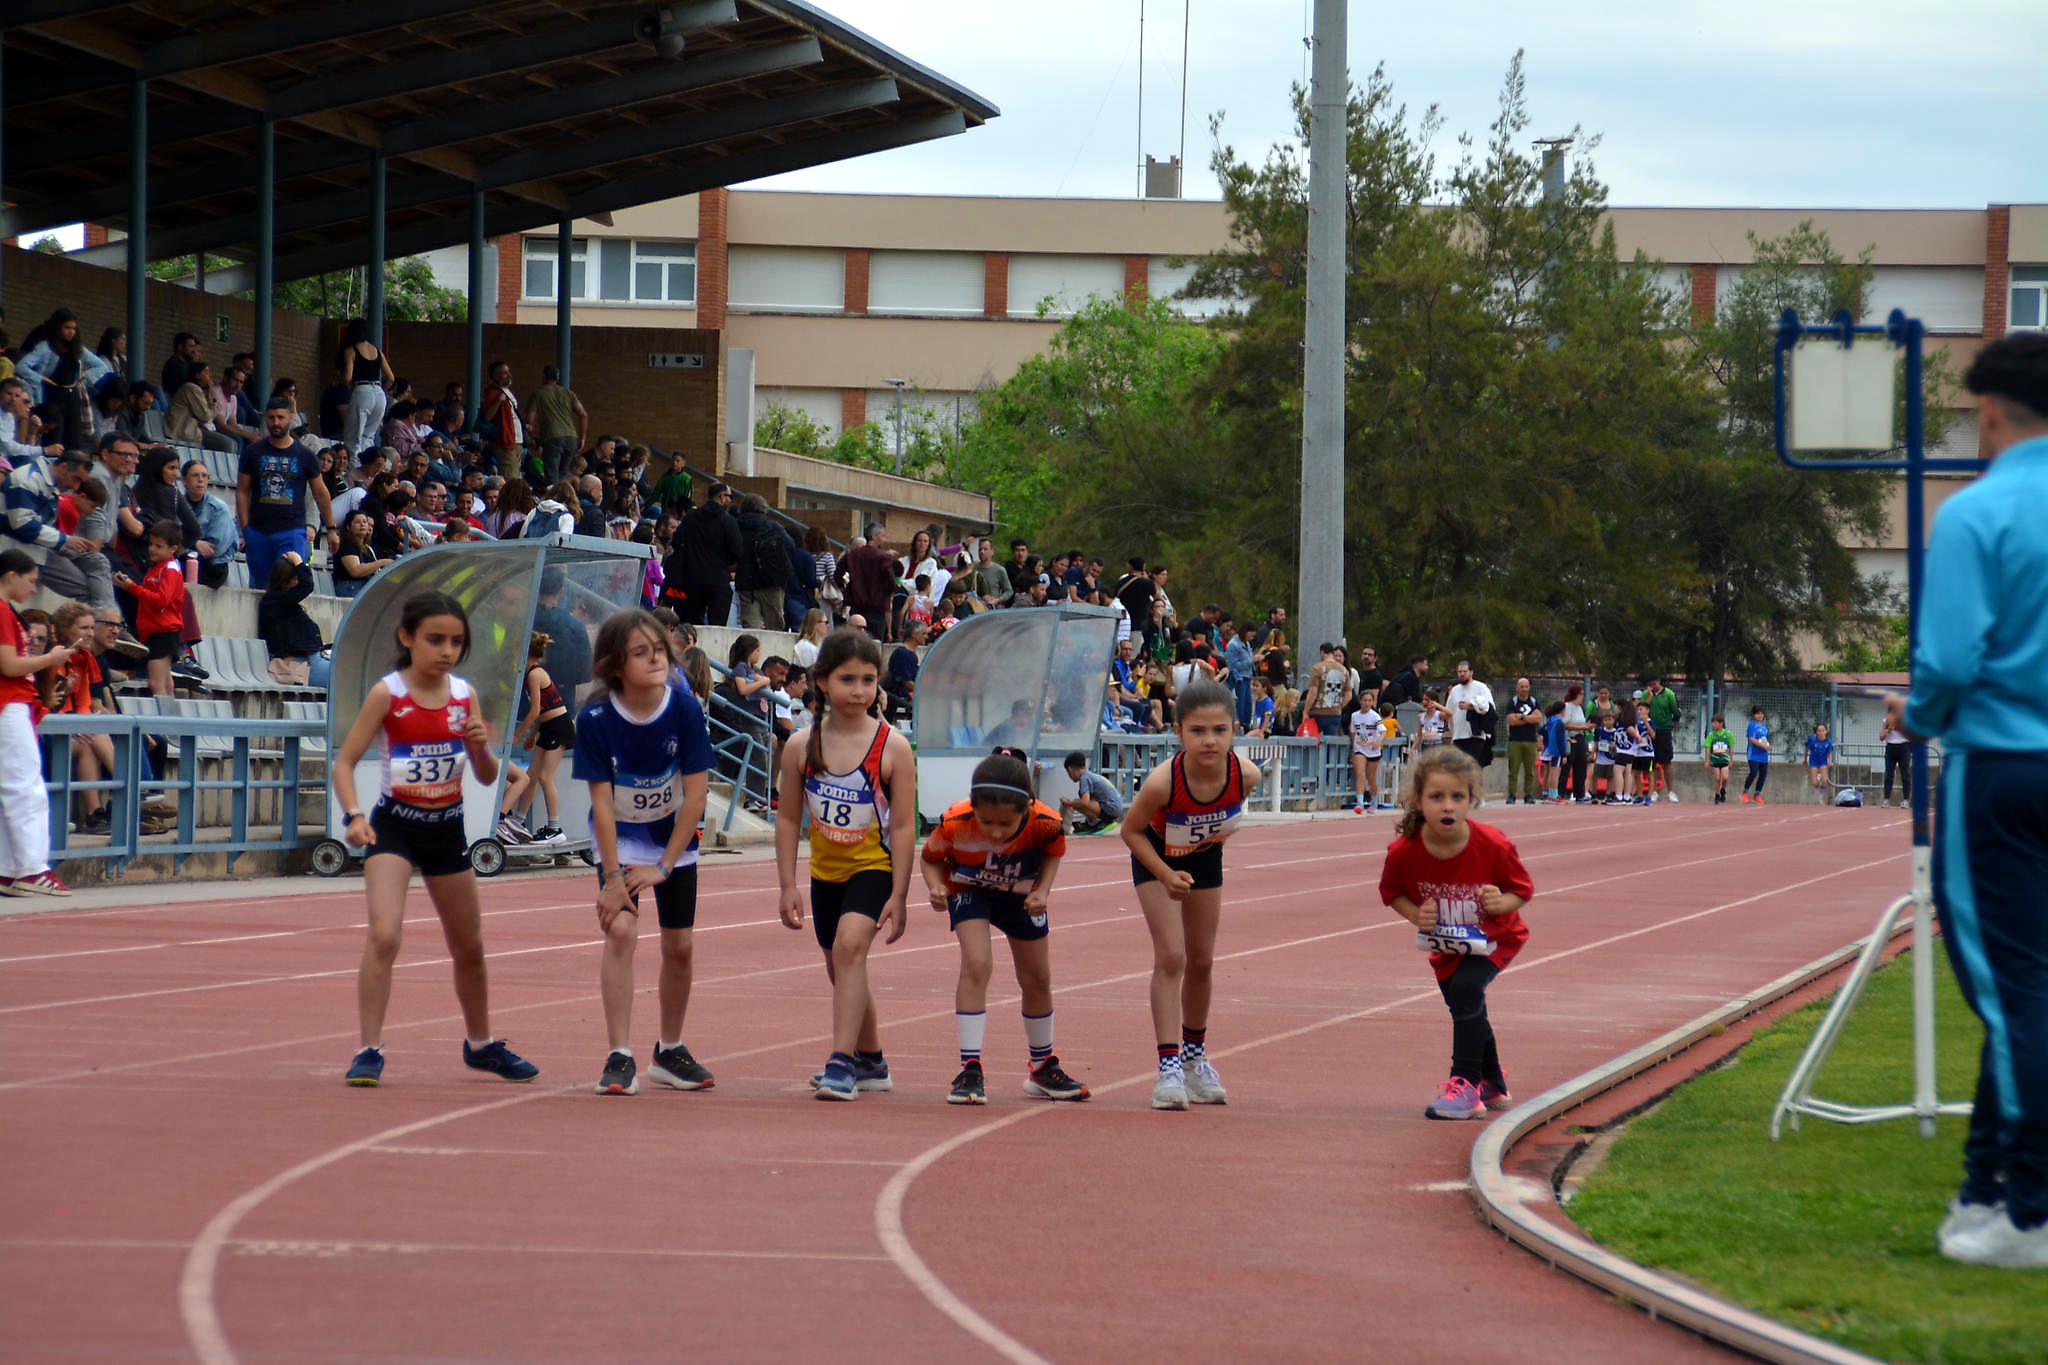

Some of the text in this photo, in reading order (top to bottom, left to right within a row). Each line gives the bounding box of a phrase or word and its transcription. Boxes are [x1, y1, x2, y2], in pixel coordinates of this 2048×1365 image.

[411, 743, 453, 757] Joma
[406, 758, 456, 783] 337
[633, 786, 672, 809] 928
[817, 783, 859, 802] Joma
[391, 804, 441, 822] NIKE
[819, 800, 852, 827] 18
[1184, 811, 1227, 825] Joma
[1189, 823, 1221, 843] 55
